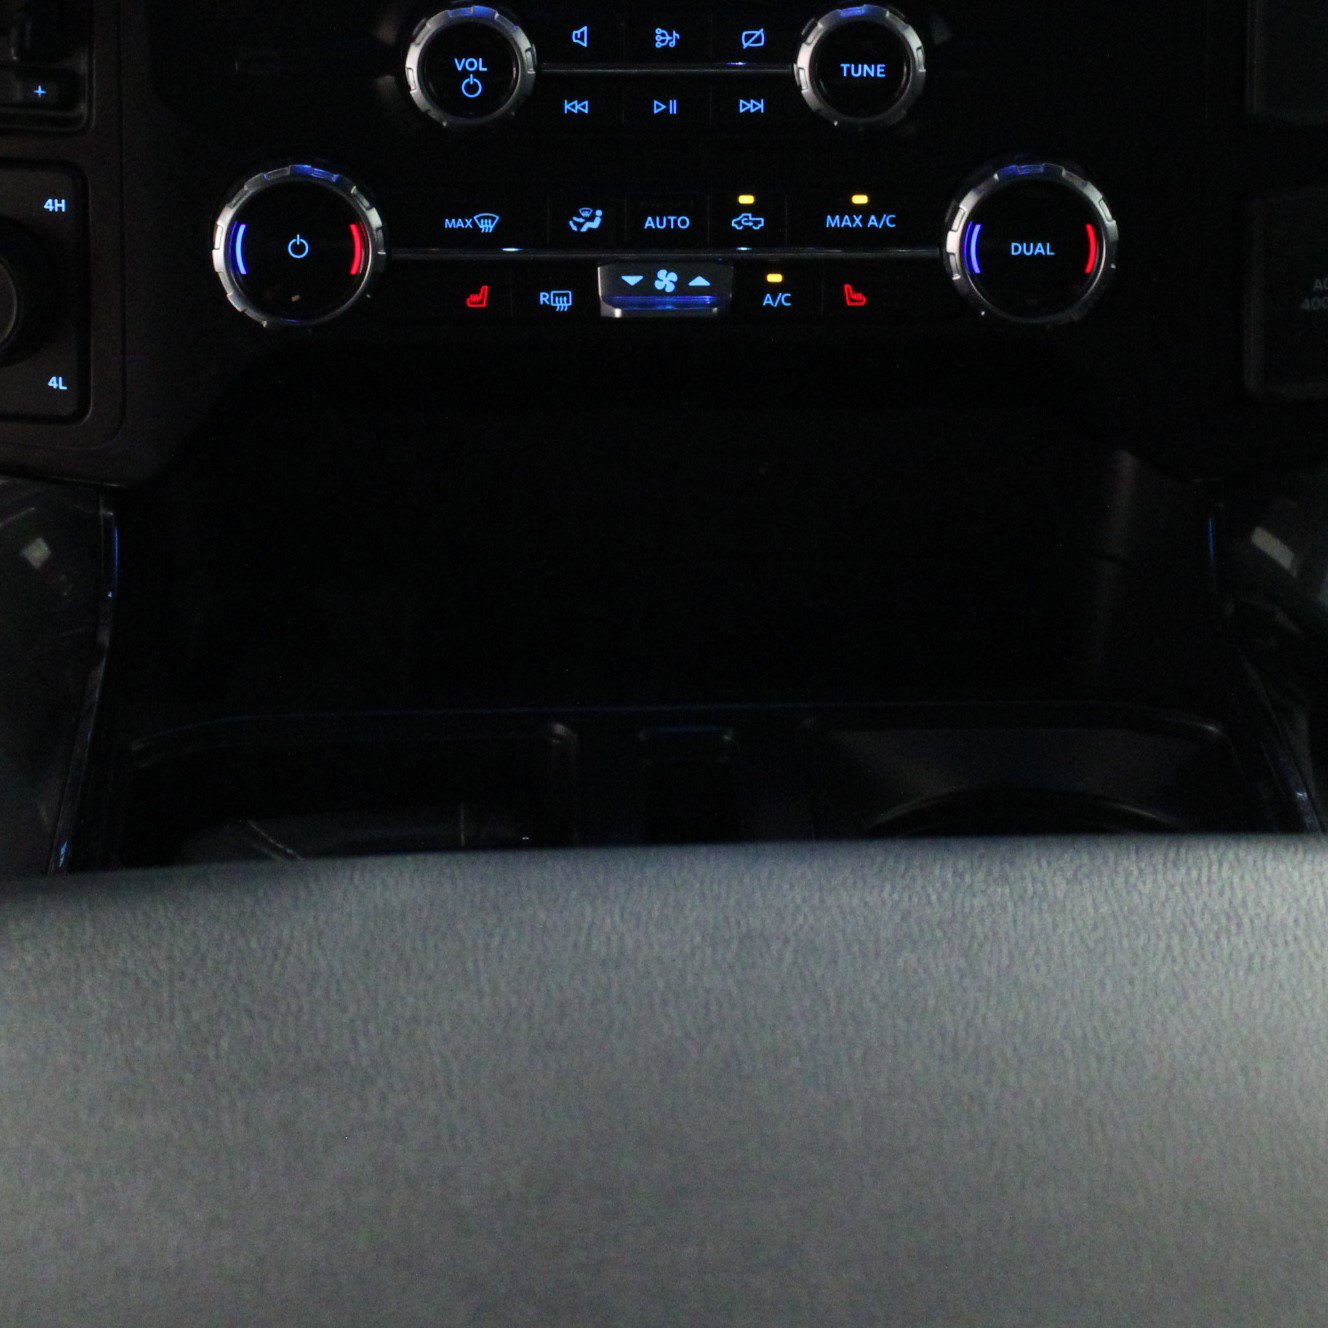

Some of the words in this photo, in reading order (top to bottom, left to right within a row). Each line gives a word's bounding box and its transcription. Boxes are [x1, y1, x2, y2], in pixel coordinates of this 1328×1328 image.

[454, 57, 488, 72] VOL
[840, 63, 886, 78] TUNE
[43, 198, 66, 212] 4H
[444, 216, 474, 229] MAX
[644, 215, 690, 230] AUTO
[825, 214, 862, 228] MAX
[866, 214, 896, 229] A/C
[1010, 242, 1055, 256] DUAL
[762, 292, 792, 308] A/C
[47, 376, 68, 390] 4L
